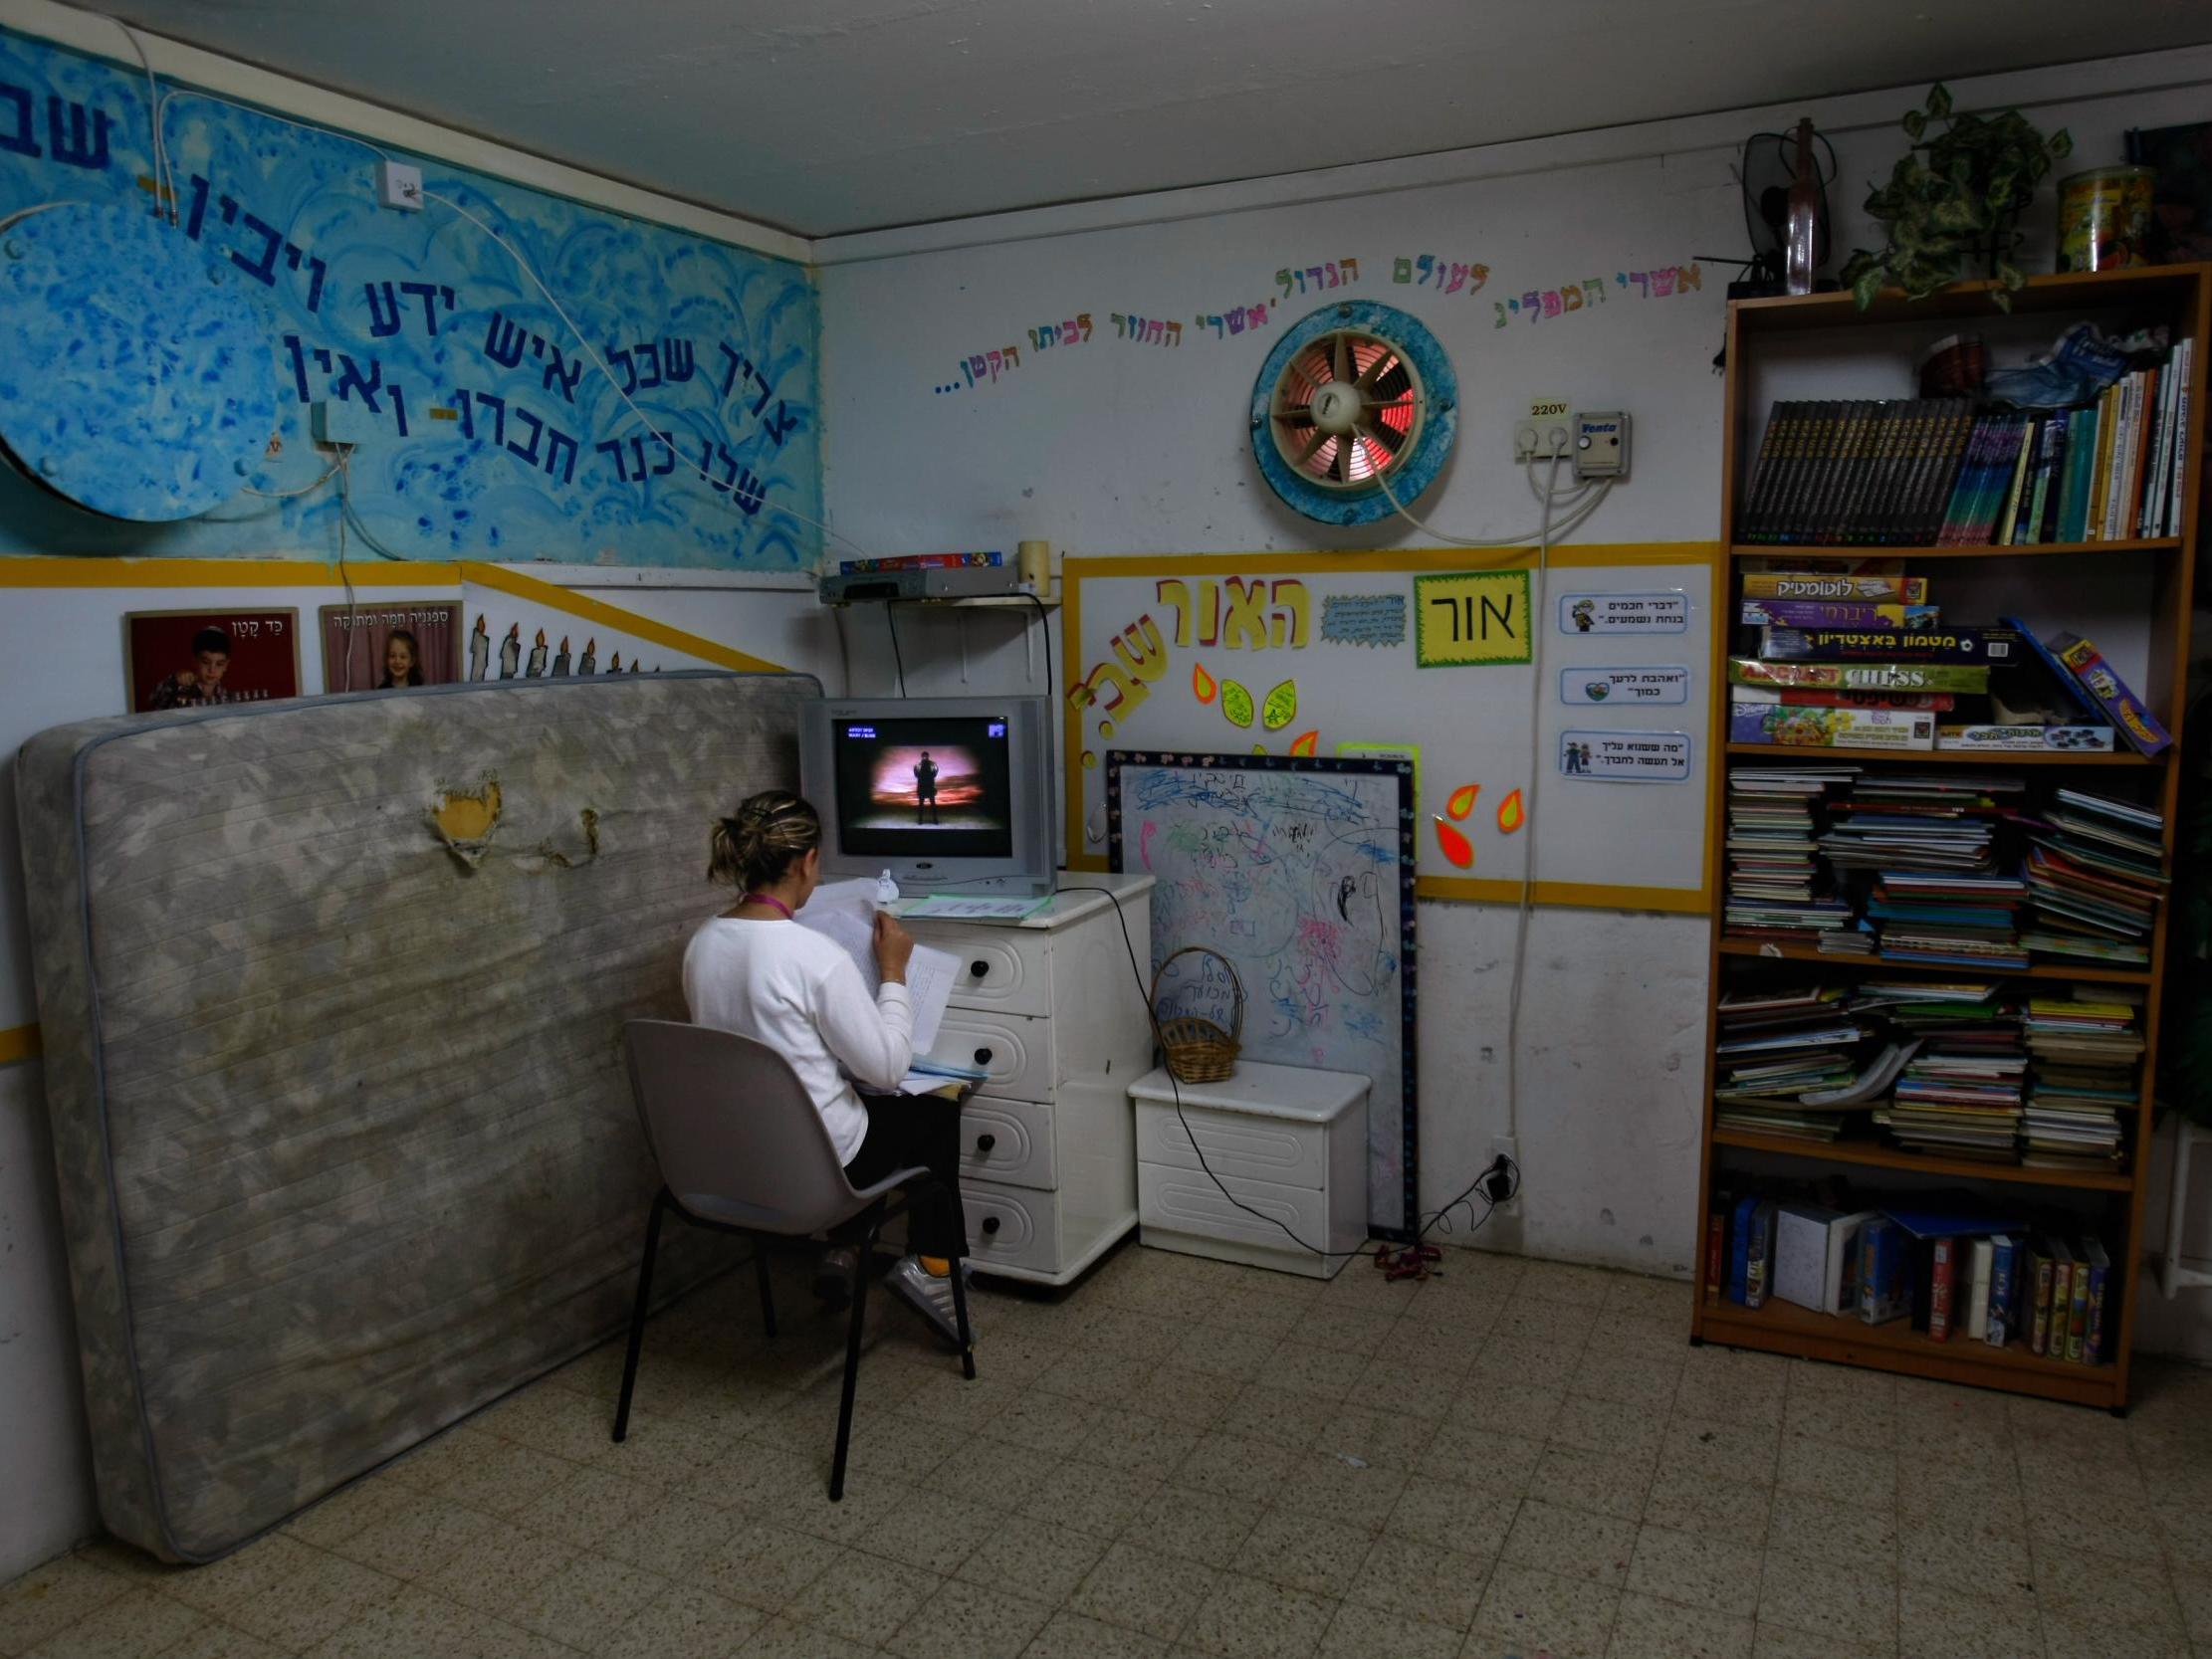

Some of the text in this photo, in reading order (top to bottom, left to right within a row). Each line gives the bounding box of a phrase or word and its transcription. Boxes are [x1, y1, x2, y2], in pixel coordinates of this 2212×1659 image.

[185, 173, 328, 311] ויבין
[1392, 254, 1491, 296] לעולם
[1616, 256, 1705, 299] אשרי
[364, 282, 459, 338] ידע
[1197, 305, 1268, 340] אשרי
[1027, 312, 1094, 352] לביתו
[1110, 311, 1183, 347] החוזר
[484, 311, 583, 404] איש
[603, 336, 696, 398] שכל
[283, 335, 767, 517] שלו כנר חברו ואין
[1531, 403, 1567, 416] 220V
[1777, 578, 1855, 597] לוטומטיק
[1156, 574, 1311, 651] האור
[1431, 593, 1517, 643] אור
[1609, 601, 1644, 611] חכמים
[1656, 615, 1684, 624] בנחת
[1609, 674, 1638, 685] לרעך
[1845, 667, 1925, 688] CHESS
[1602, 740, 1624, 751] עליך
[1626, 742, 1661, 752] ששנוא
[1637, 756, 1668, 765] תעשה
[1671, 756, 1685, 767] אל
